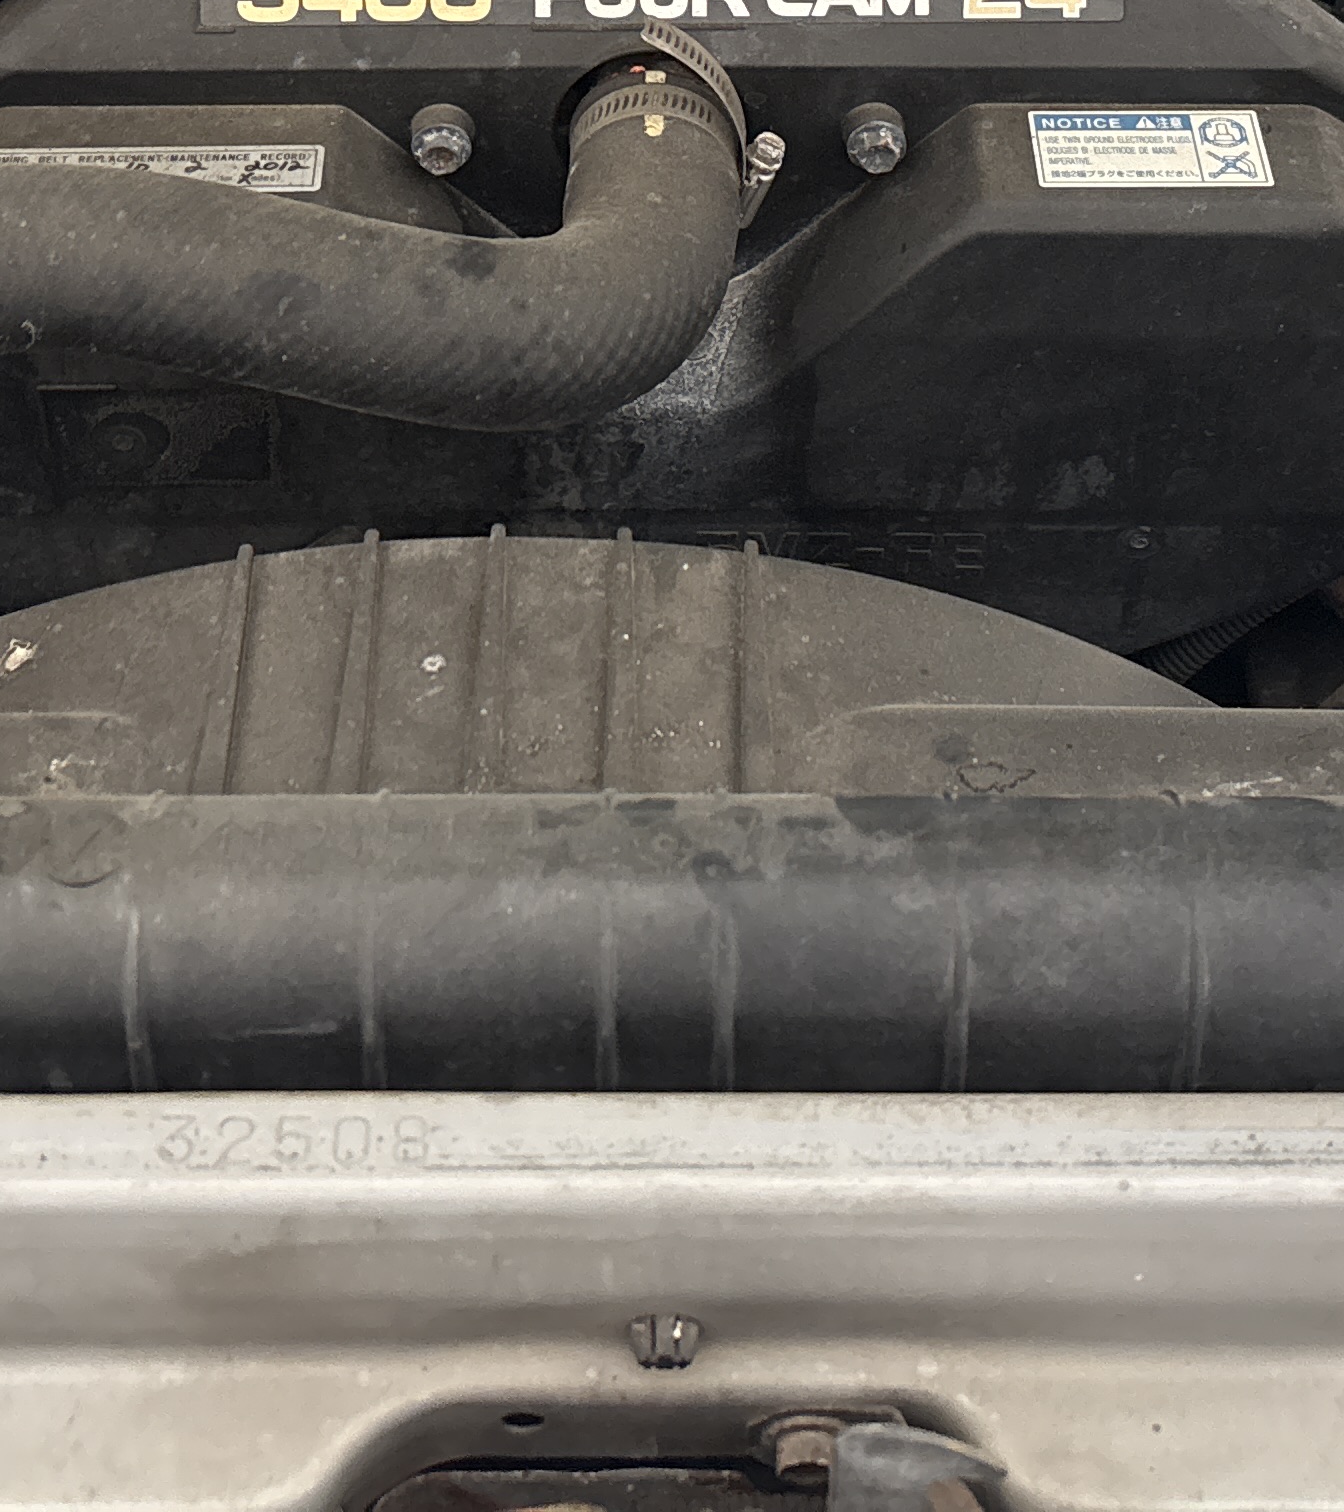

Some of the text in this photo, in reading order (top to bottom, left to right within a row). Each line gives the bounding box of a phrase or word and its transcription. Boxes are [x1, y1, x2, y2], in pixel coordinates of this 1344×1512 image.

[1041, 117, 1122, 129] NOTICE
[1156, 116, 1184, 130] 注意
[38, 154, 69, 164] BELT
[244, 160, 311, 172] 2012
[156, 1114, 430, 1170] 32508
